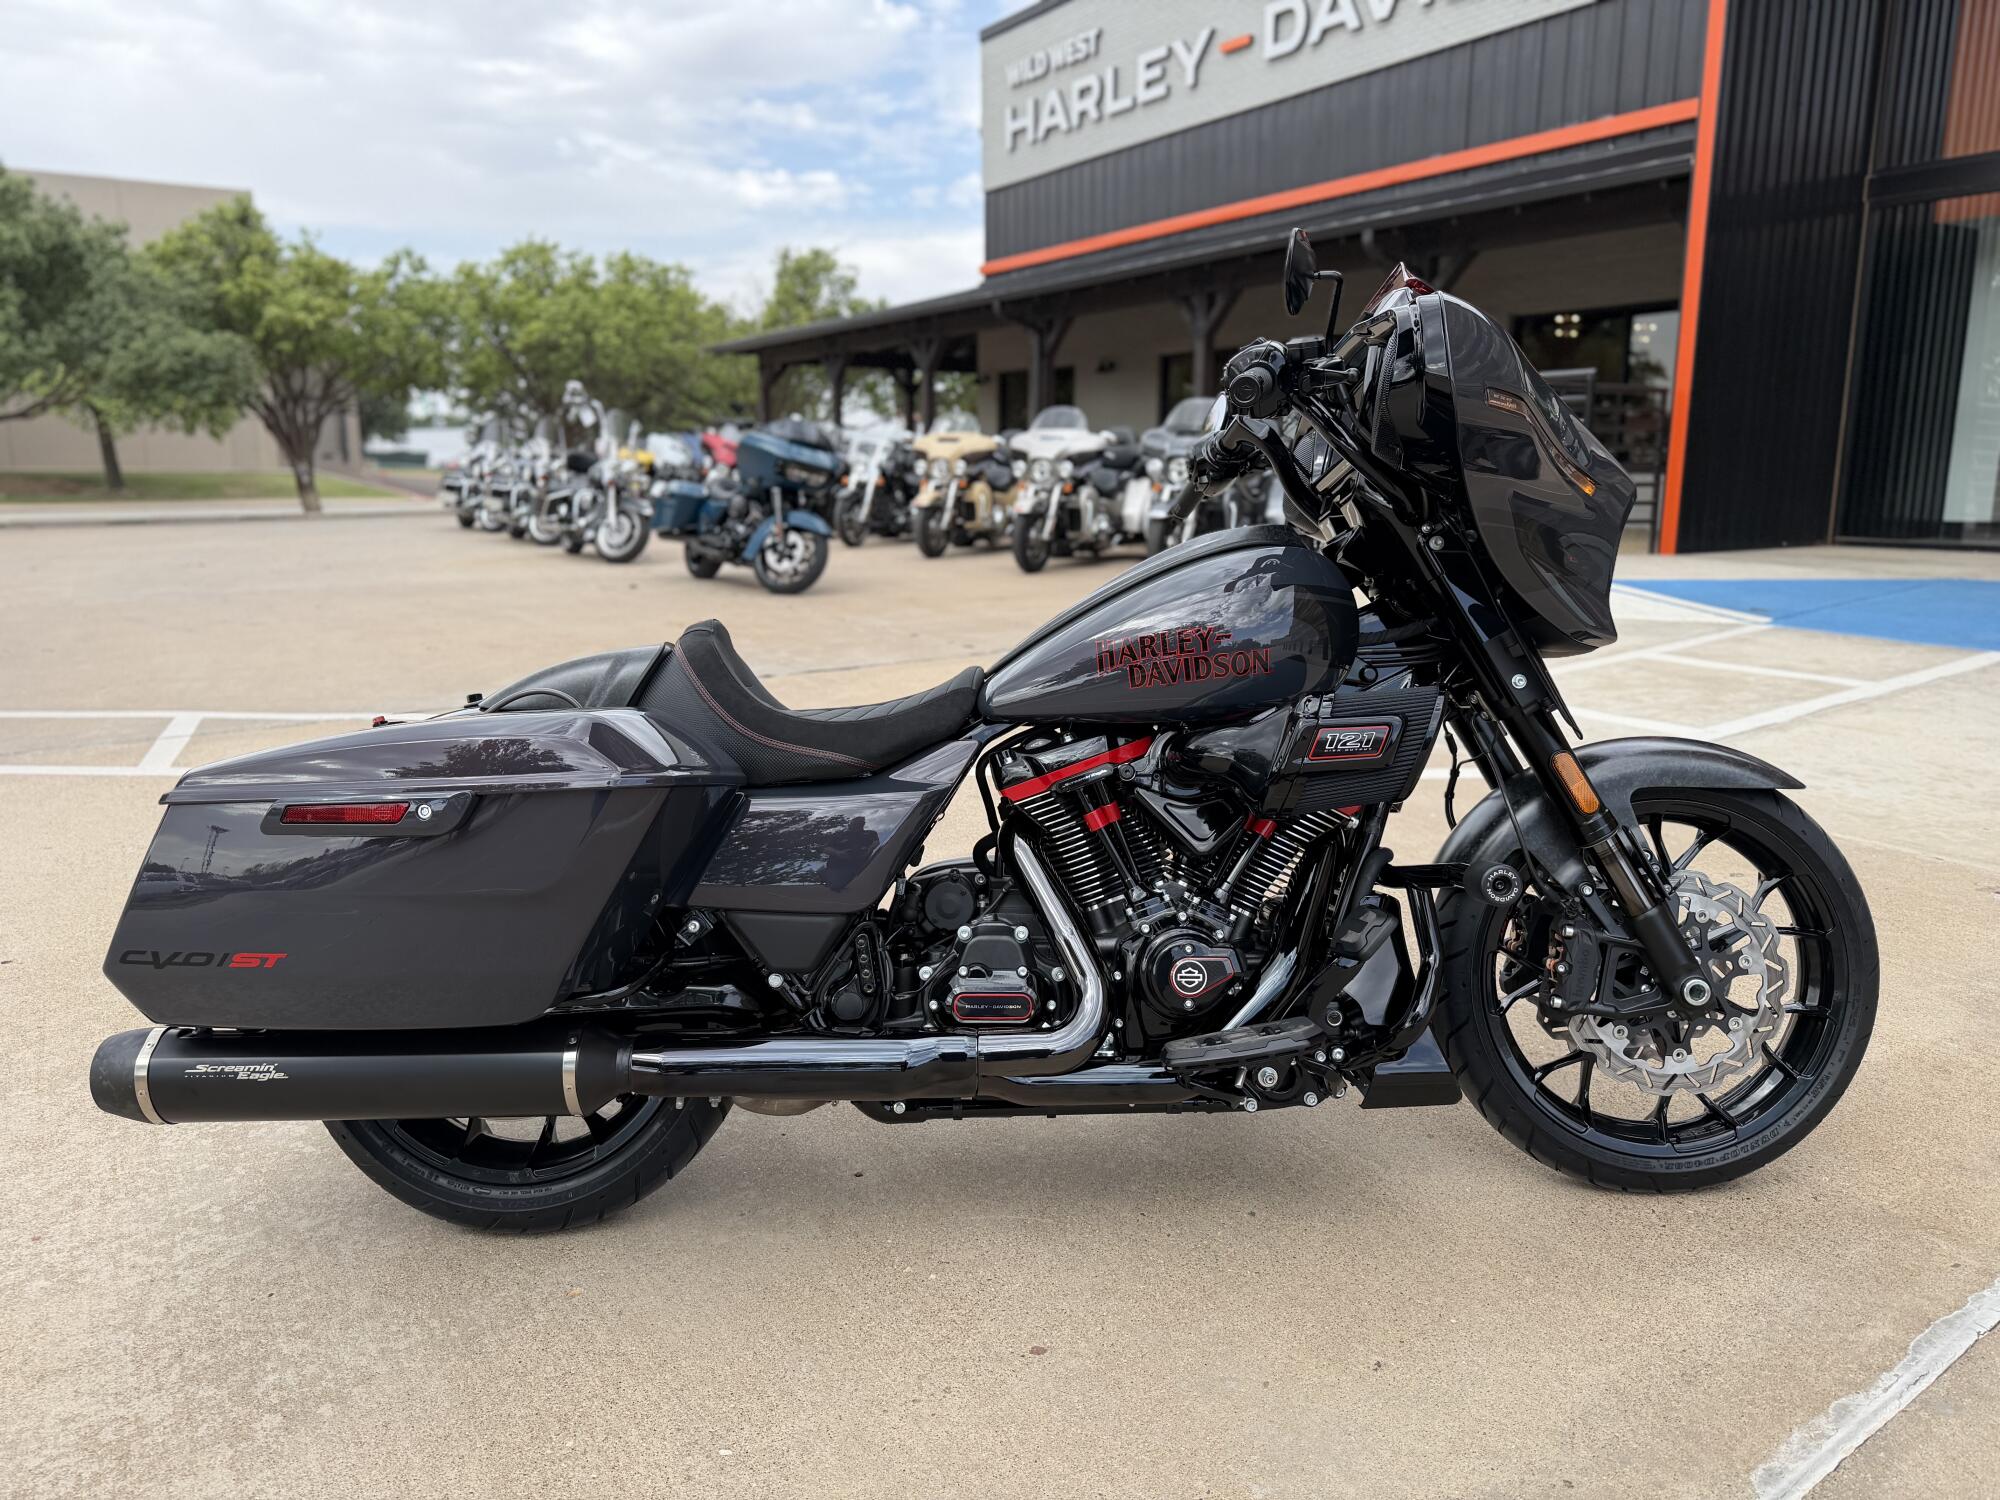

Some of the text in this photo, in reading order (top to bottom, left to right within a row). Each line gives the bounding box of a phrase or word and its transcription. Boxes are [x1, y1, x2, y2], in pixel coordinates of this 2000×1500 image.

[1006, 27, 1103, 88] WILD WEST
[1127, 648, 1272, 689] DAVIDSON
[1325, 732, 1376, 749] 121
[1488, 869, 1517, 881] HARLEY
[1486, 887, 1519, 903] DAVIDSON
[119, 950, 288, 970] CVO ST
[184, 1062, 279, 1073] Screamin'
[236, 1070, 288, 1082] Eagle
